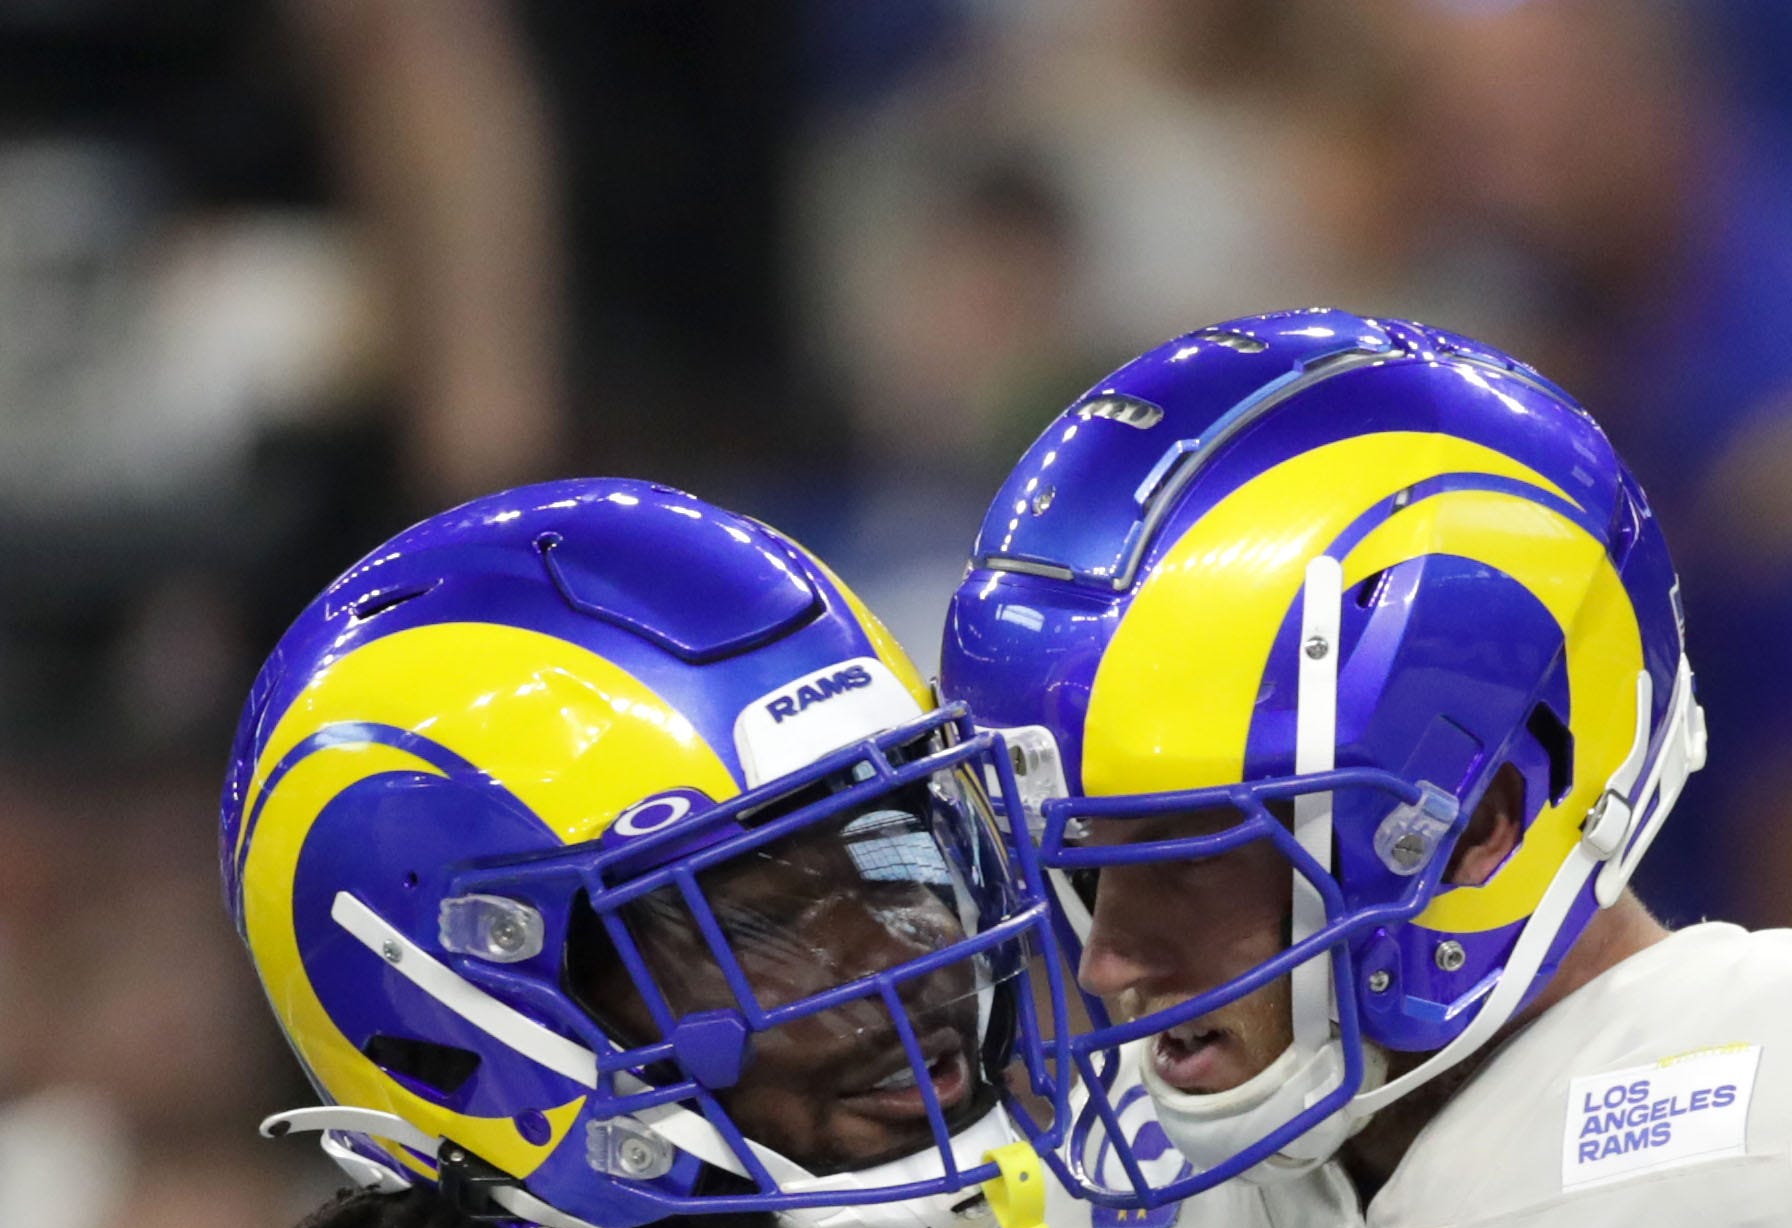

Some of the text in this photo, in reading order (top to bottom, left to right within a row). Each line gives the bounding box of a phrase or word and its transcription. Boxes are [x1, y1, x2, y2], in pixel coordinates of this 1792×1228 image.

[766, 665, 872, 724] RAMS
[1579, 1085, 1737, 1139] ANGELES
[1583, 1080, 1651, 1114] LOS
[1578, 1122, 1672, 1164] RAMS
